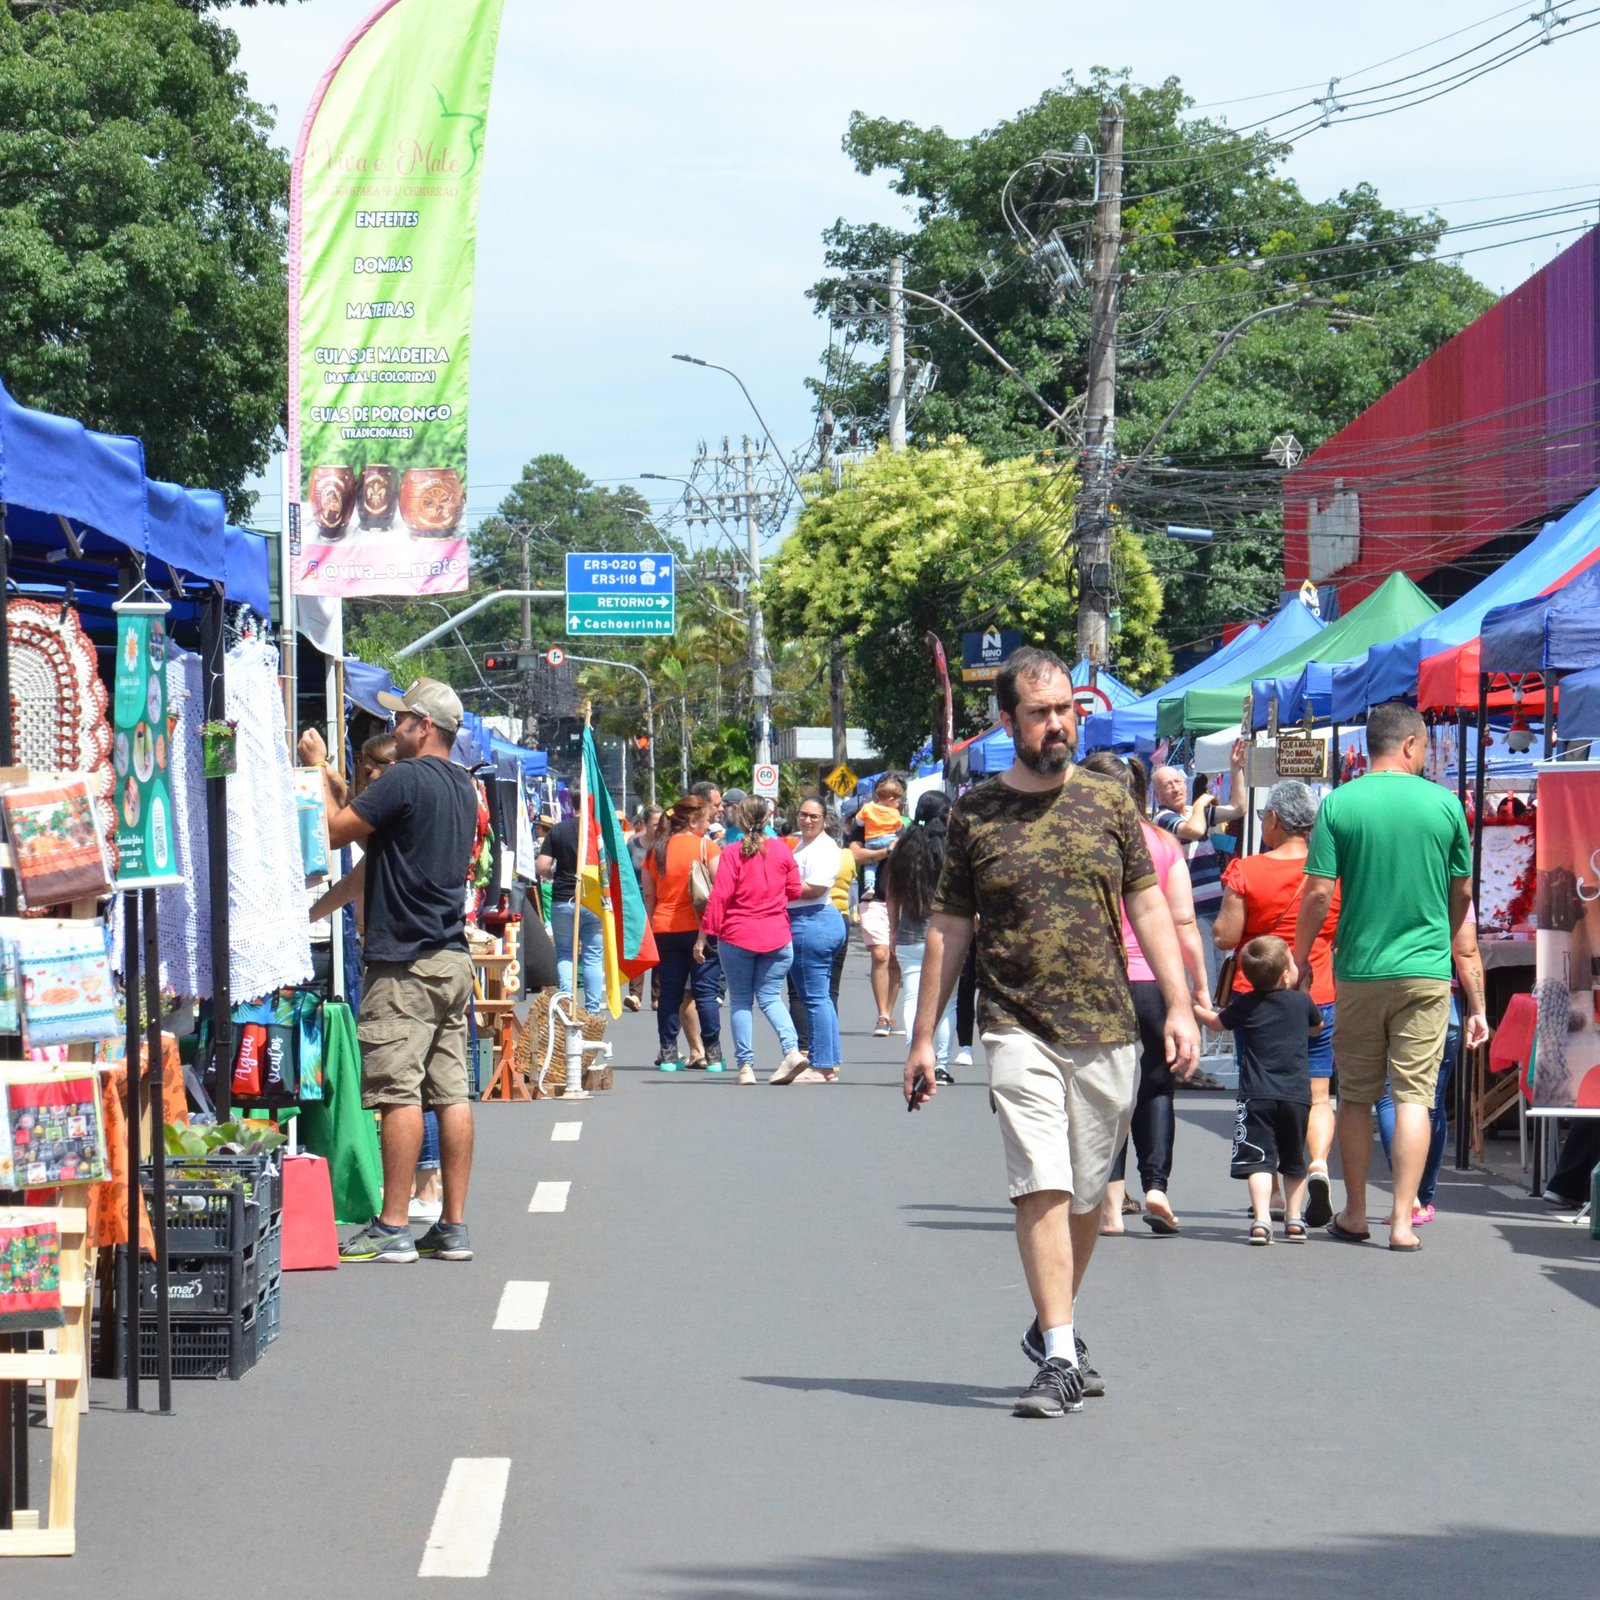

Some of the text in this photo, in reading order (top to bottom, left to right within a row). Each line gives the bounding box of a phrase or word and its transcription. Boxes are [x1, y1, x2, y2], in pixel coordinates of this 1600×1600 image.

[355, 211, 419, 228] ENFEITES
[353, 256, 413, 273] BOMBAS
[346, 301, 414, 319] MATEIRAS
[314, 347, 359, 364] CUIAS
[377, 346, 450, 364] MADEIRA
[370, 371, 378, 382] E
[379, 370, 436, 383] COLORIDA)
[352, 406, 369, 422] DE
[370, 405, 452, 423] PORONGO
[341, 427, 414, 440] (TRADICIONAIS)
[322, 556, 462, 582] @viva_o_mate
[584, 560, 637, 570] ERS-020
[592, 574, 637, 585] ERS-118
[597, 597, 654, 607] RETORNO
[584, 618, 671, 629] Cachoeirinha
[982, 649, 1002, 658] NINO
[760, 770, 772, 779] 60
